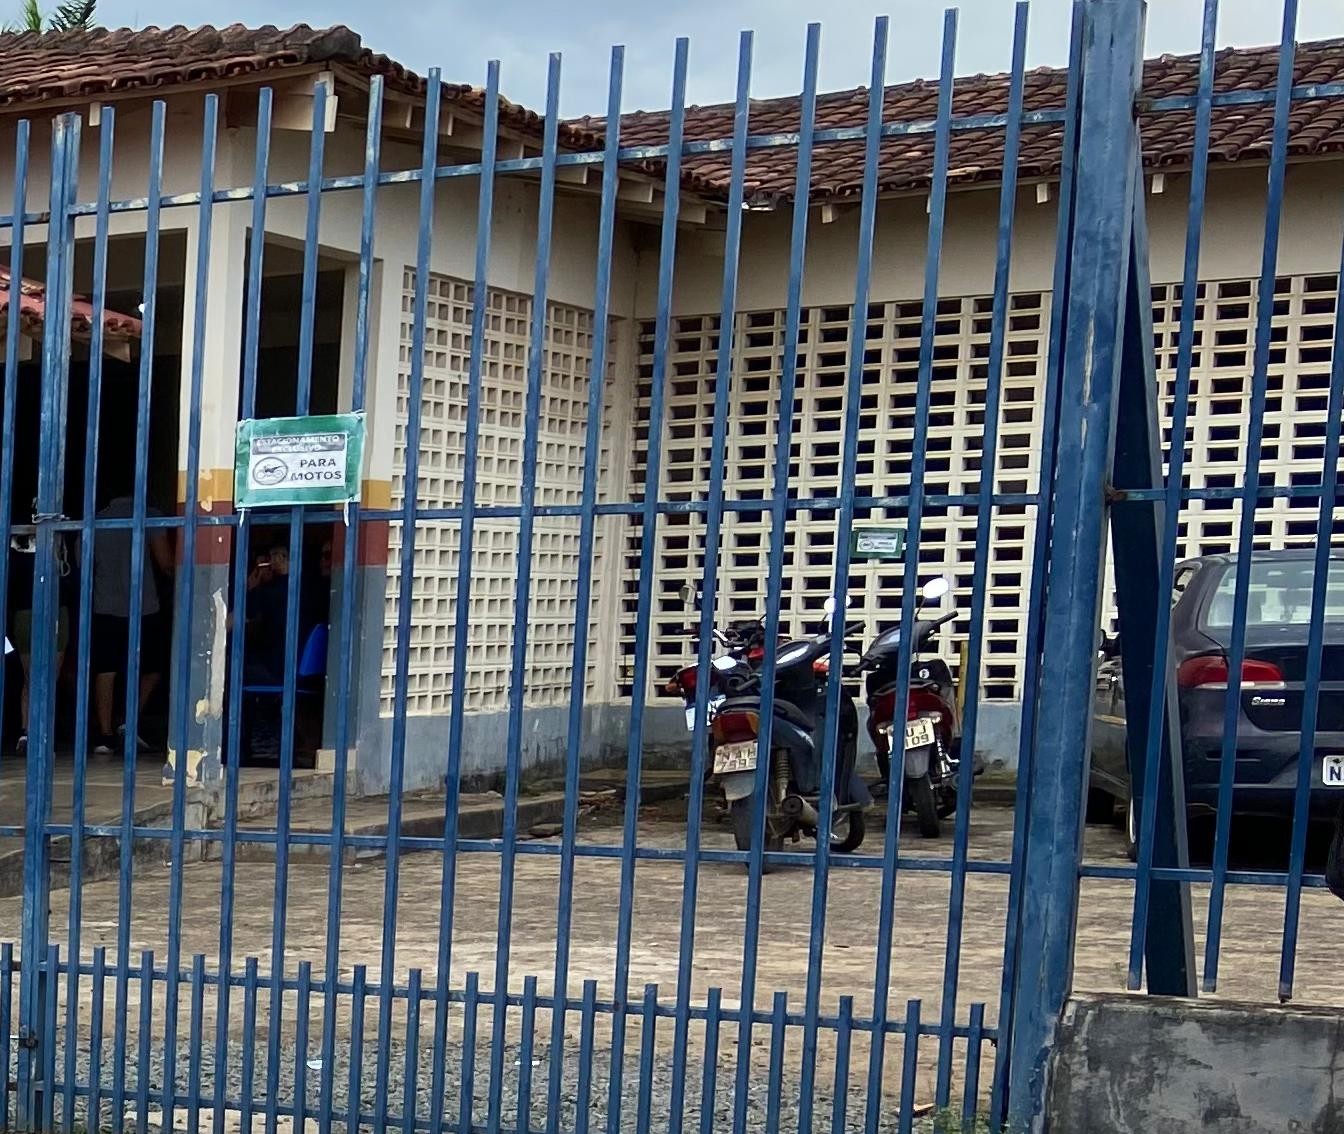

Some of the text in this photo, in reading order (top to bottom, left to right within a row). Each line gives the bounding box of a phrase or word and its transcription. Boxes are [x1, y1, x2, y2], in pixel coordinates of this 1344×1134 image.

[256, 435, 339, 446] ESTACIONAMENTO
[300, 458, 336, 468] PARA
[290, 470, 342, 481] MOTOS
